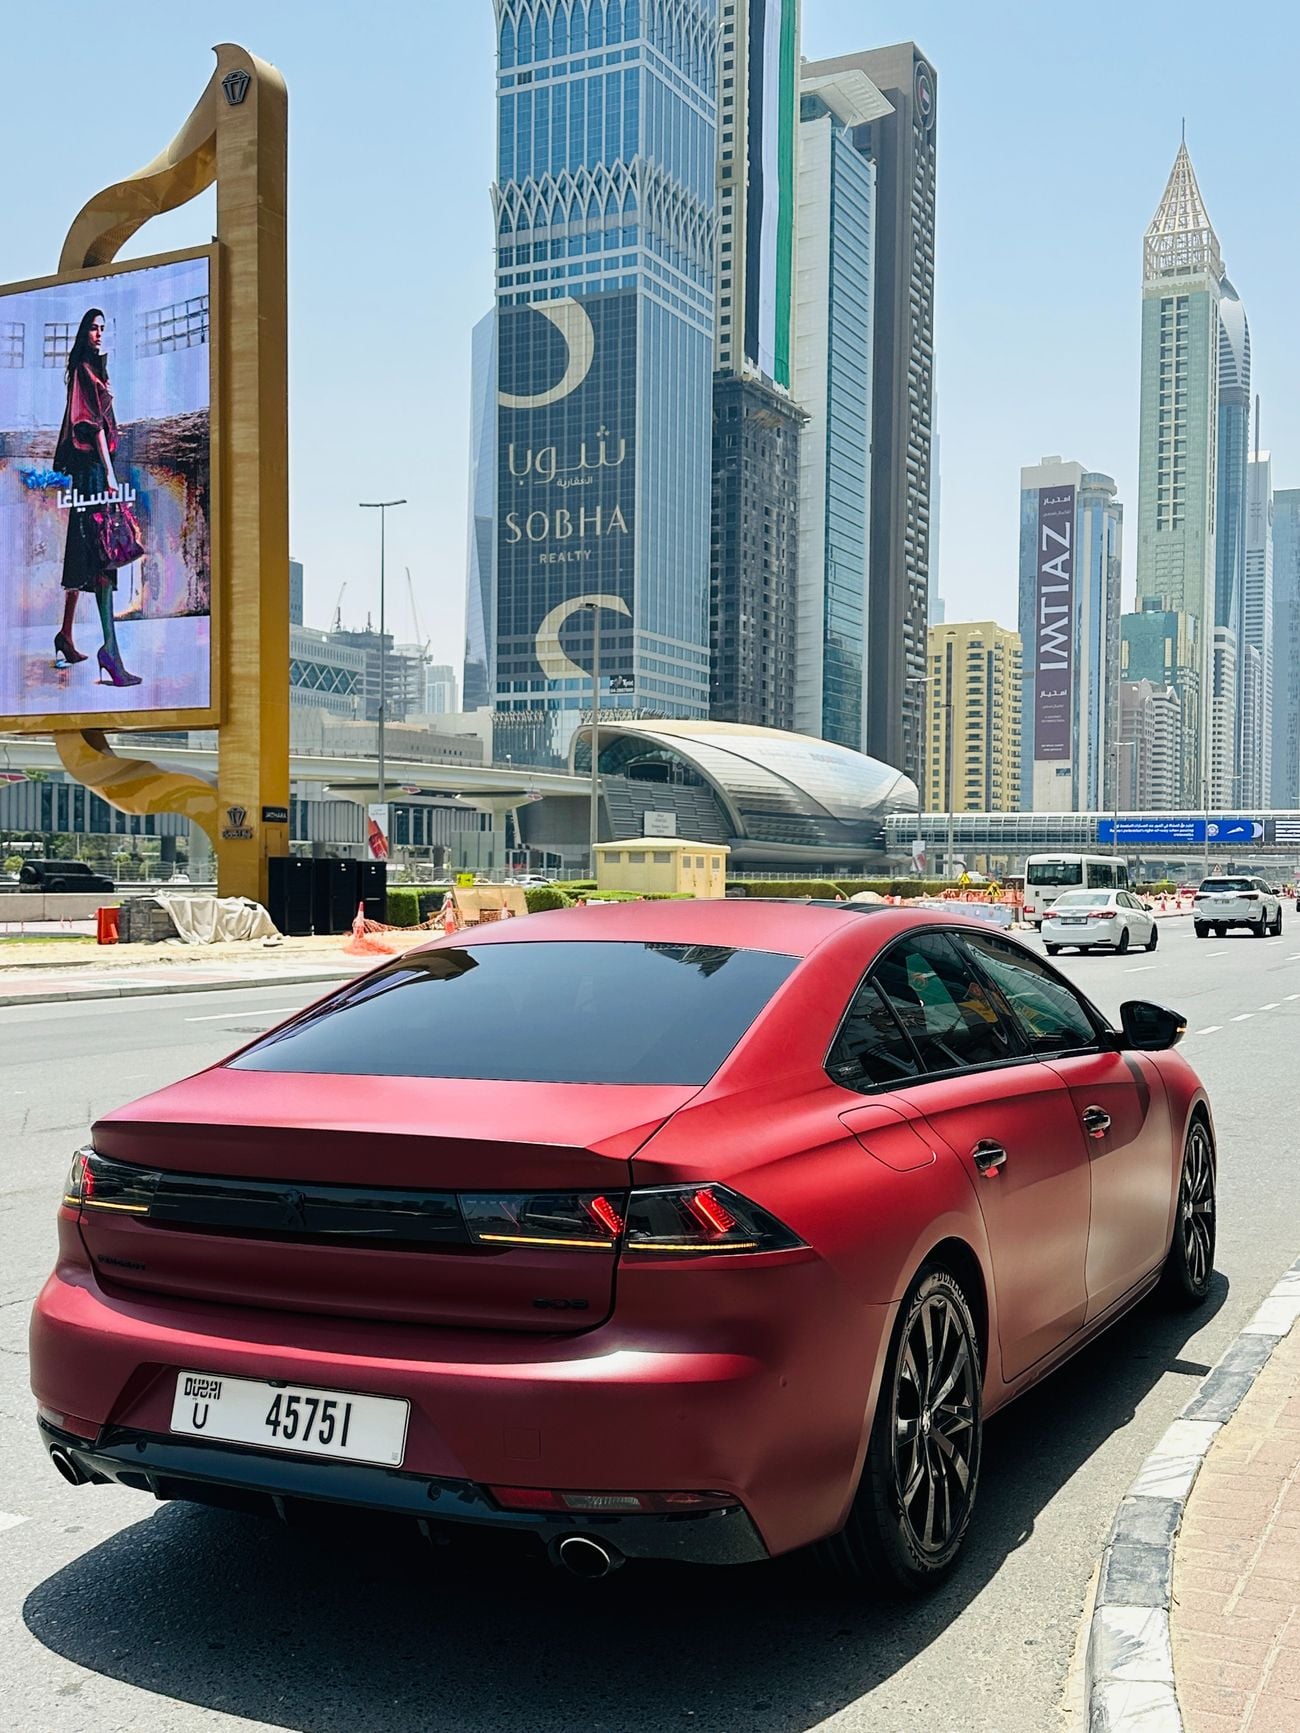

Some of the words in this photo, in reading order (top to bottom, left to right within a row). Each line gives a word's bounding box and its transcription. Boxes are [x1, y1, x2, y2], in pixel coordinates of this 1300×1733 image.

[505, 503, 628, 543] SOBHA
[539, 549, 592, 564] REALTY
[1039, 521, 1070, 671] IMTIAZ
[192, 1403, 208, 1429] U
[265, 1393, 352, 1447] 45751
